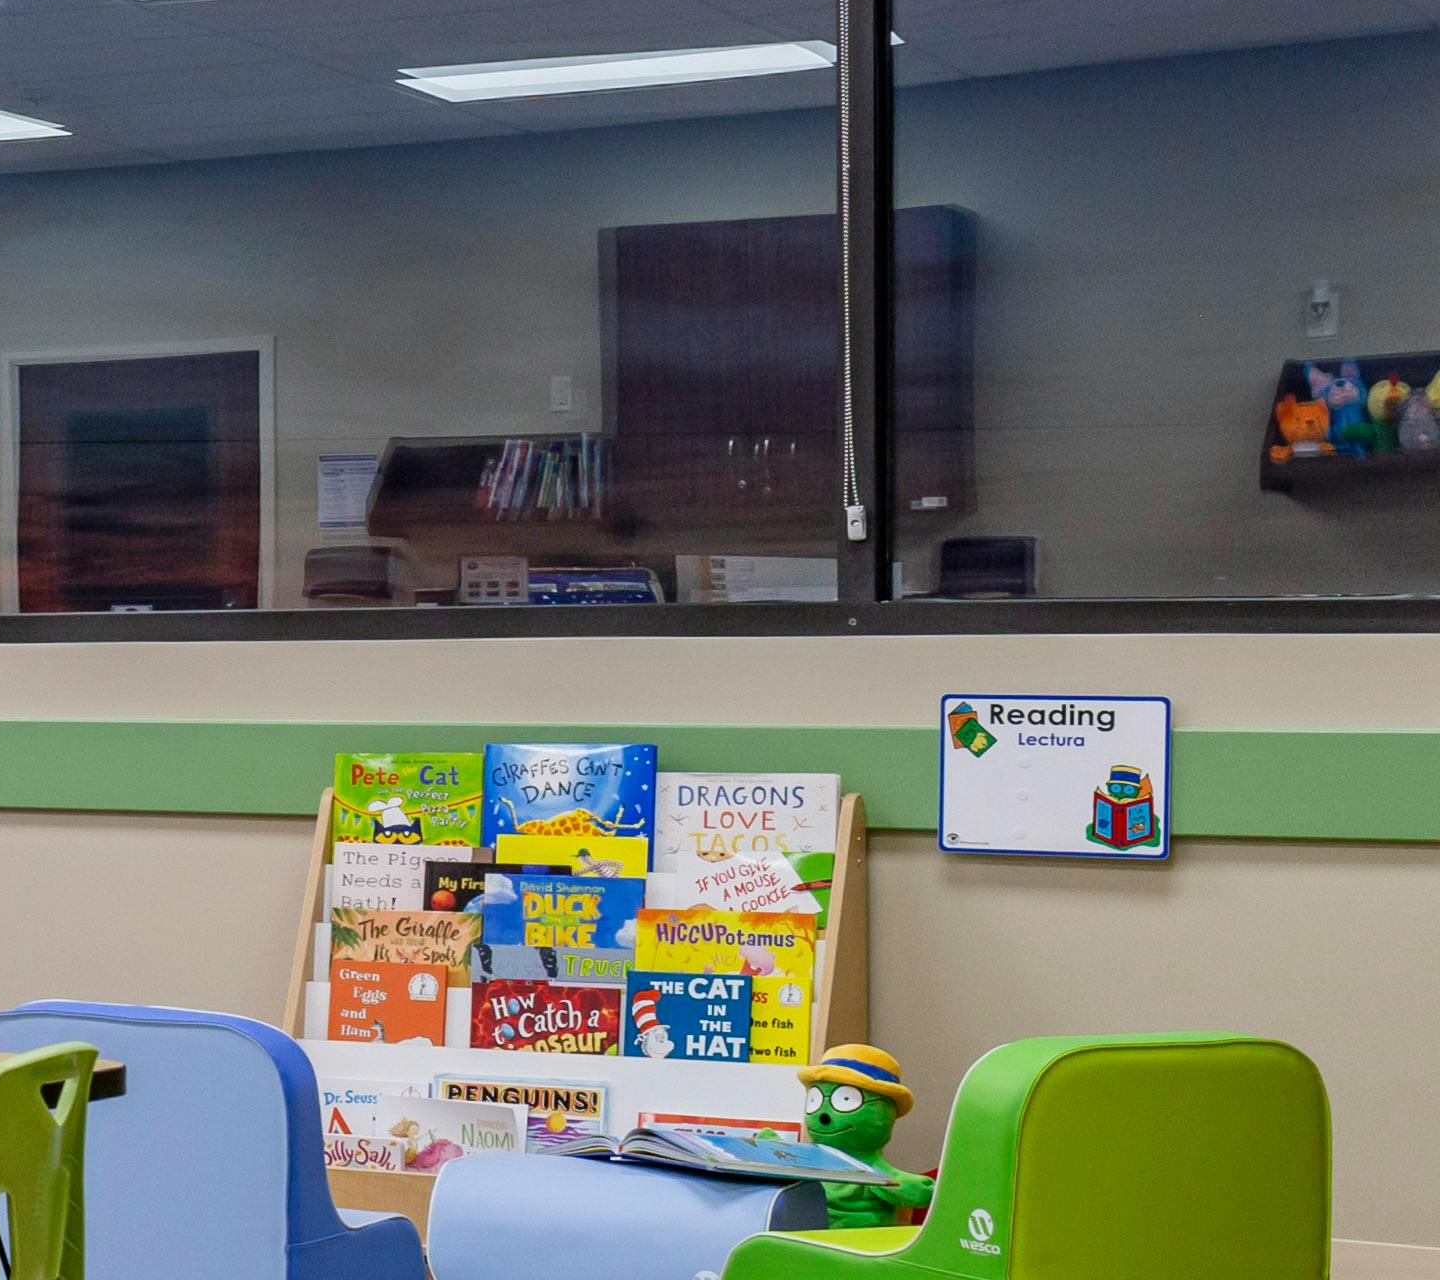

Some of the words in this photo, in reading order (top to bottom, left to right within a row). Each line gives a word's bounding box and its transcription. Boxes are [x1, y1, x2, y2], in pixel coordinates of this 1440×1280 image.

[990, 704, 1116, 732] Reading
[1018, 732, 1085, 747] Lectura
[351, 763, 400, 785] Pete
[419, 765, 459, 785] Cat
[522, 781, 596, 804] DANCE
[678, 785, 806, 809] DRAGONS
[703, 810, 776, 831] LOVE
[689, 833, 791, 852] TACOS
[343, 851, 379, 866] The
[341, 874, 402, 889] Needs
[411, 878, 421, 889] a
[711, 866, 737, 887] YOU
[738, 857, 771, 877] GIVE
[438, 877, 458, 891] My
[461, 877, 485, 890] Firs
[520, 881, 553, 891] David
[556, 882, 606, 893] Shannon
[723, 888, 731, 902] A
[735, 873, 781, 897] MOUSE
[341, 895, 397, 910] Bath!
[523, 892, 602, 920] DUCK
[741, 885, 792, 913] COOKIE
[358, 919, 389, 941] The
[395, 917, 462, 945] Giraffe
[525, 922, 598, 949] BIKE
[339, 968, 380, 982] Green
[353, 985, 387, 1004] Eggs
[649, 981, 684, 995] THE
[688, 977, 745, 1000] CAT
[341, 1008, 367, 1019] and
[517, 1000, 582, 1038] Catch
[588, 1009, 600, 1028] a
[707, 1004, 726, 1016] IN
[341, 1024, 371, 1037] Ham
[699, 1020, 732, 1033] THE
[771, 1018, 794, 1030] fish
[686, 1034, 746, 1058] HAT
[749, 1047, 771, 1056] two
[774, 1046, 796, 1057] fish
[324, 1091, 343, 1105] Dr.
[447, 1084, 598, 1113] PENGUINS!
[461, 1123, 515, 1149] NAOMI
